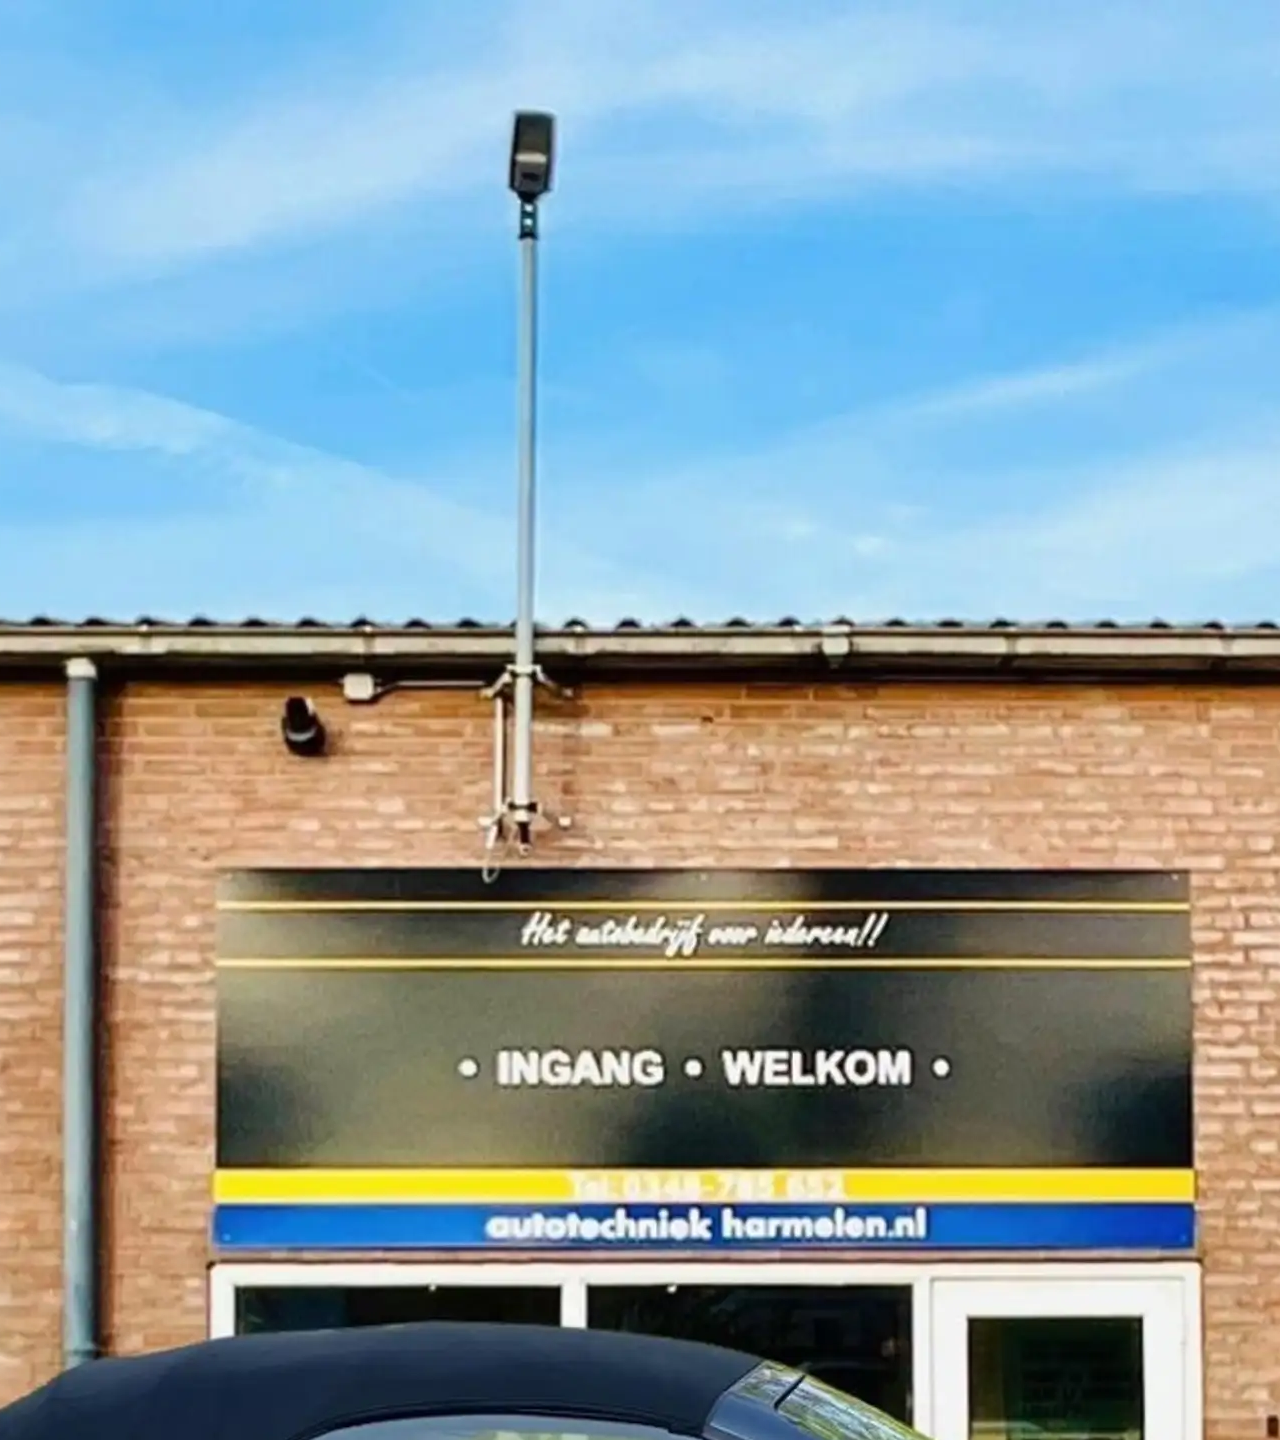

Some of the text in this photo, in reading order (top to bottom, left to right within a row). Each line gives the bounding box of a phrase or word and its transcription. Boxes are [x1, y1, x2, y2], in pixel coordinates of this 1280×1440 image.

[520, 910, 889, 958] Het autobedrijf voor iedereen!!
[496, 1049, 911, 1086] INGANG WELKOM
[485, 1207, 927, 1240] autotechniek harmelen.nl
